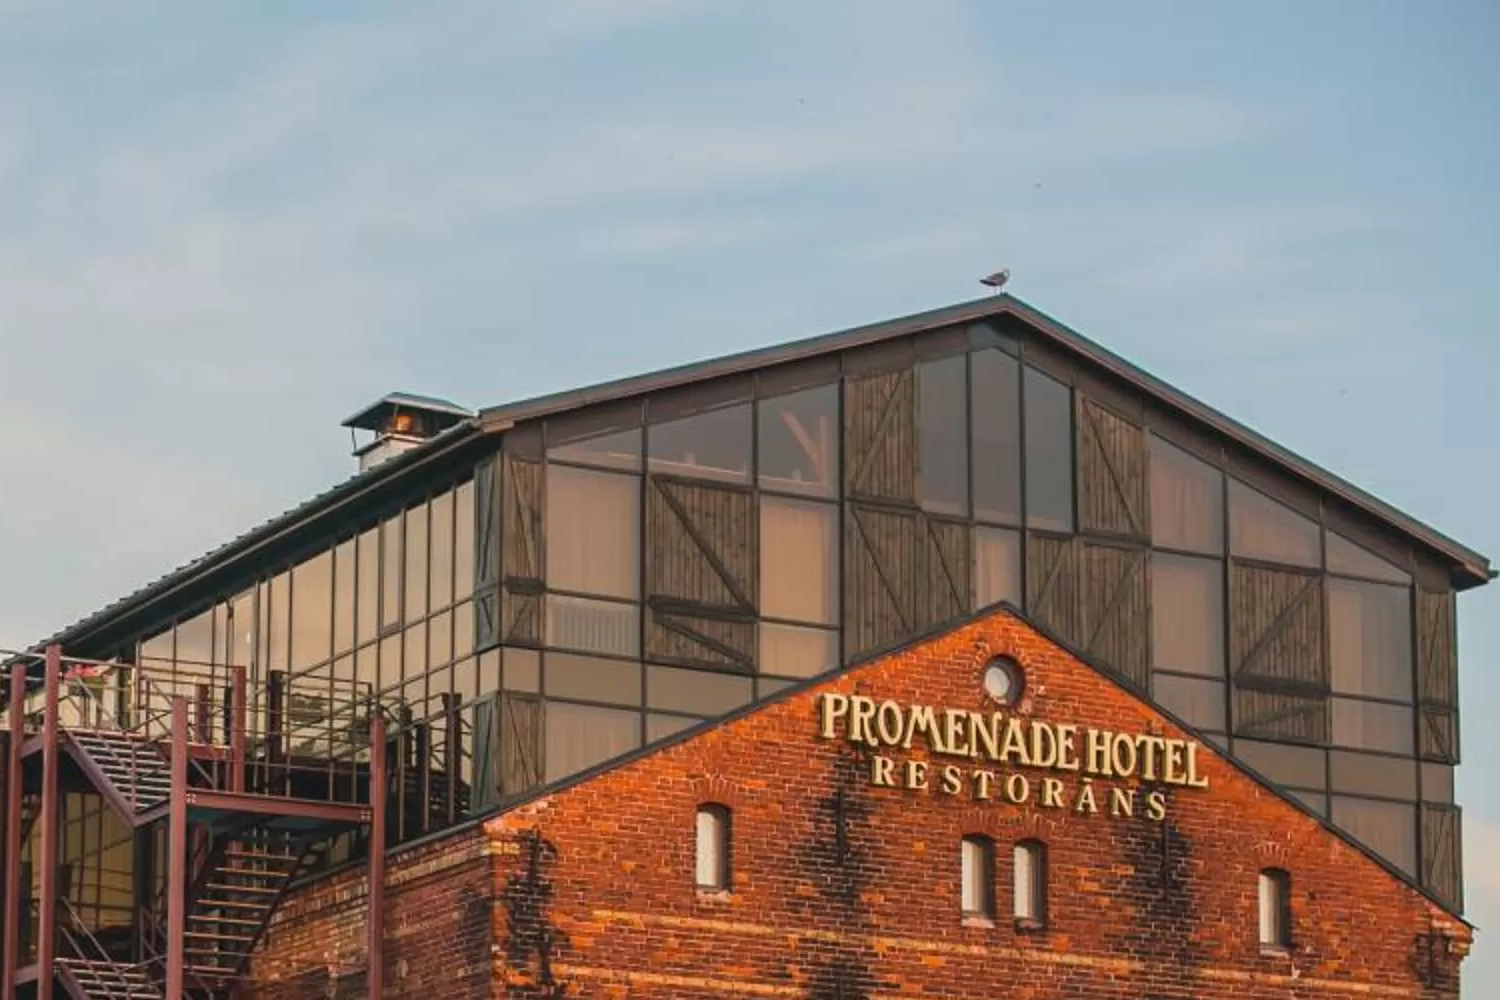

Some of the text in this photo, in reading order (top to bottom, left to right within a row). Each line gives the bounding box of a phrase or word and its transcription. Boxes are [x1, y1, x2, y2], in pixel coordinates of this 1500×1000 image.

[819, 693, 1209, 787] PROMENADE HOTEL
[871, 754, 1166, 821] RESTORĀNS
